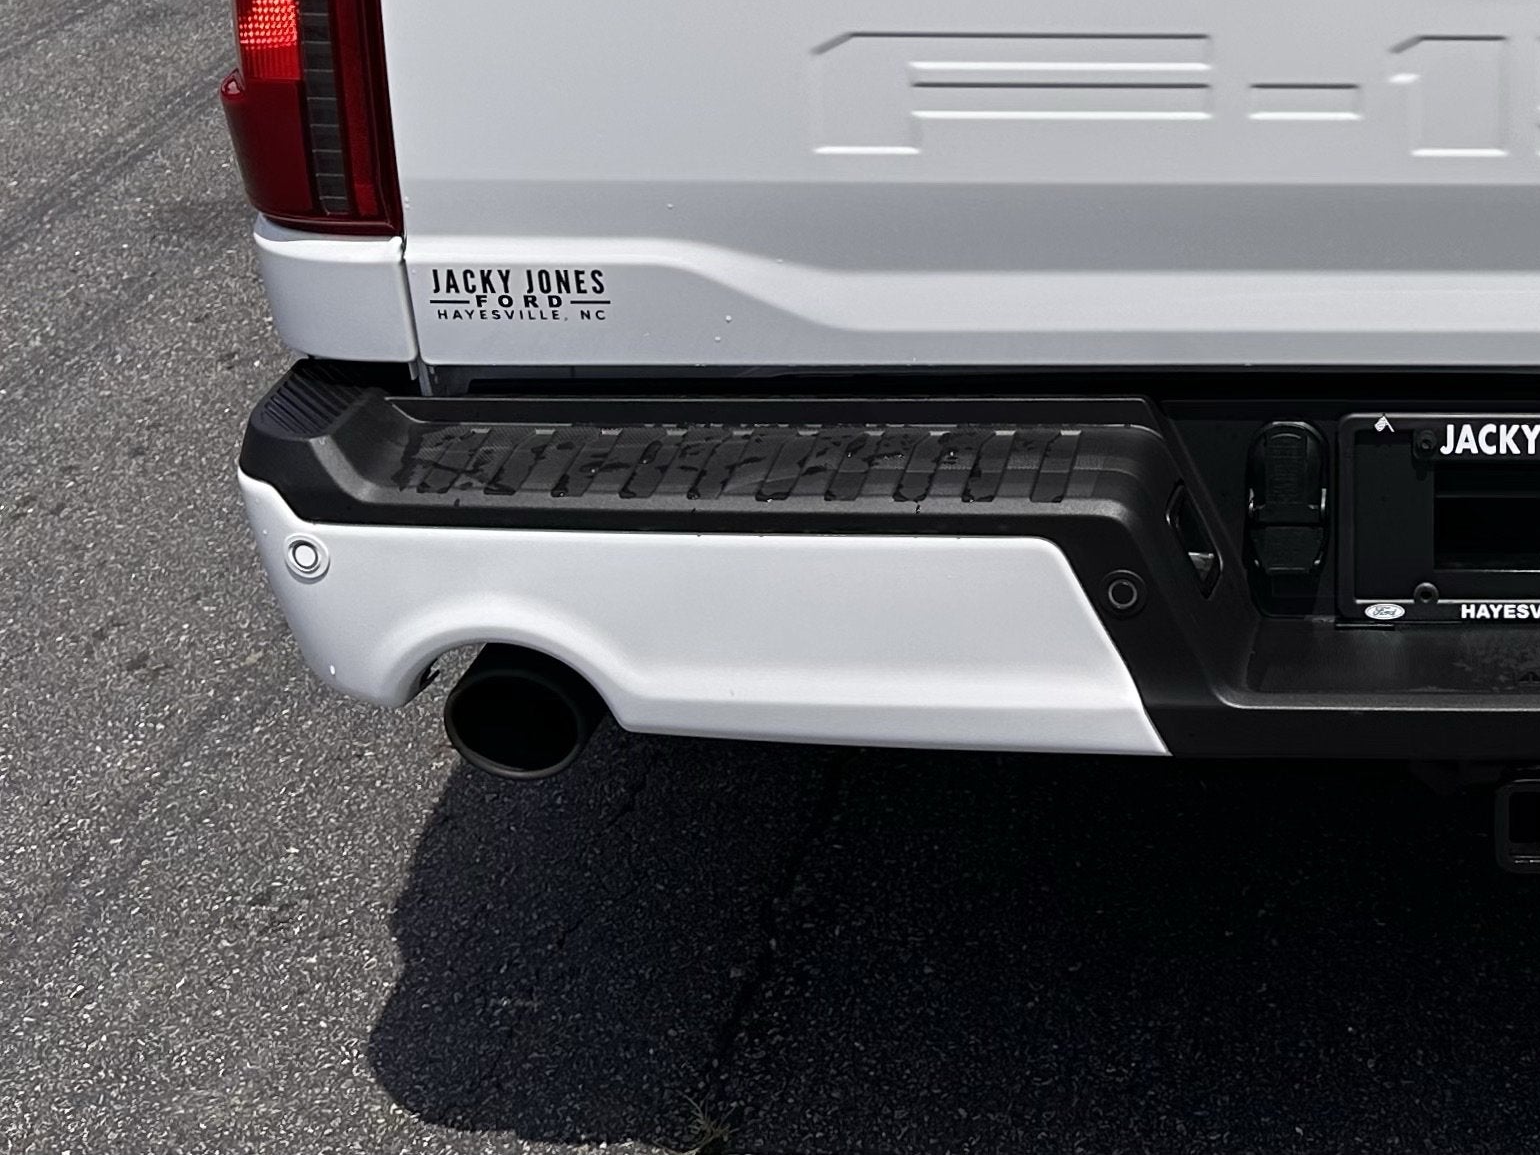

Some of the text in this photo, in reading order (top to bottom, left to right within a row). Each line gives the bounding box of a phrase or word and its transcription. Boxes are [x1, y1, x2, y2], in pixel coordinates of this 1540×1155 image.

[432, 269, 605, 294] JACKY JONES
[475, 294, 563, 308] FORD
[580, 310, 606, 320] NC
